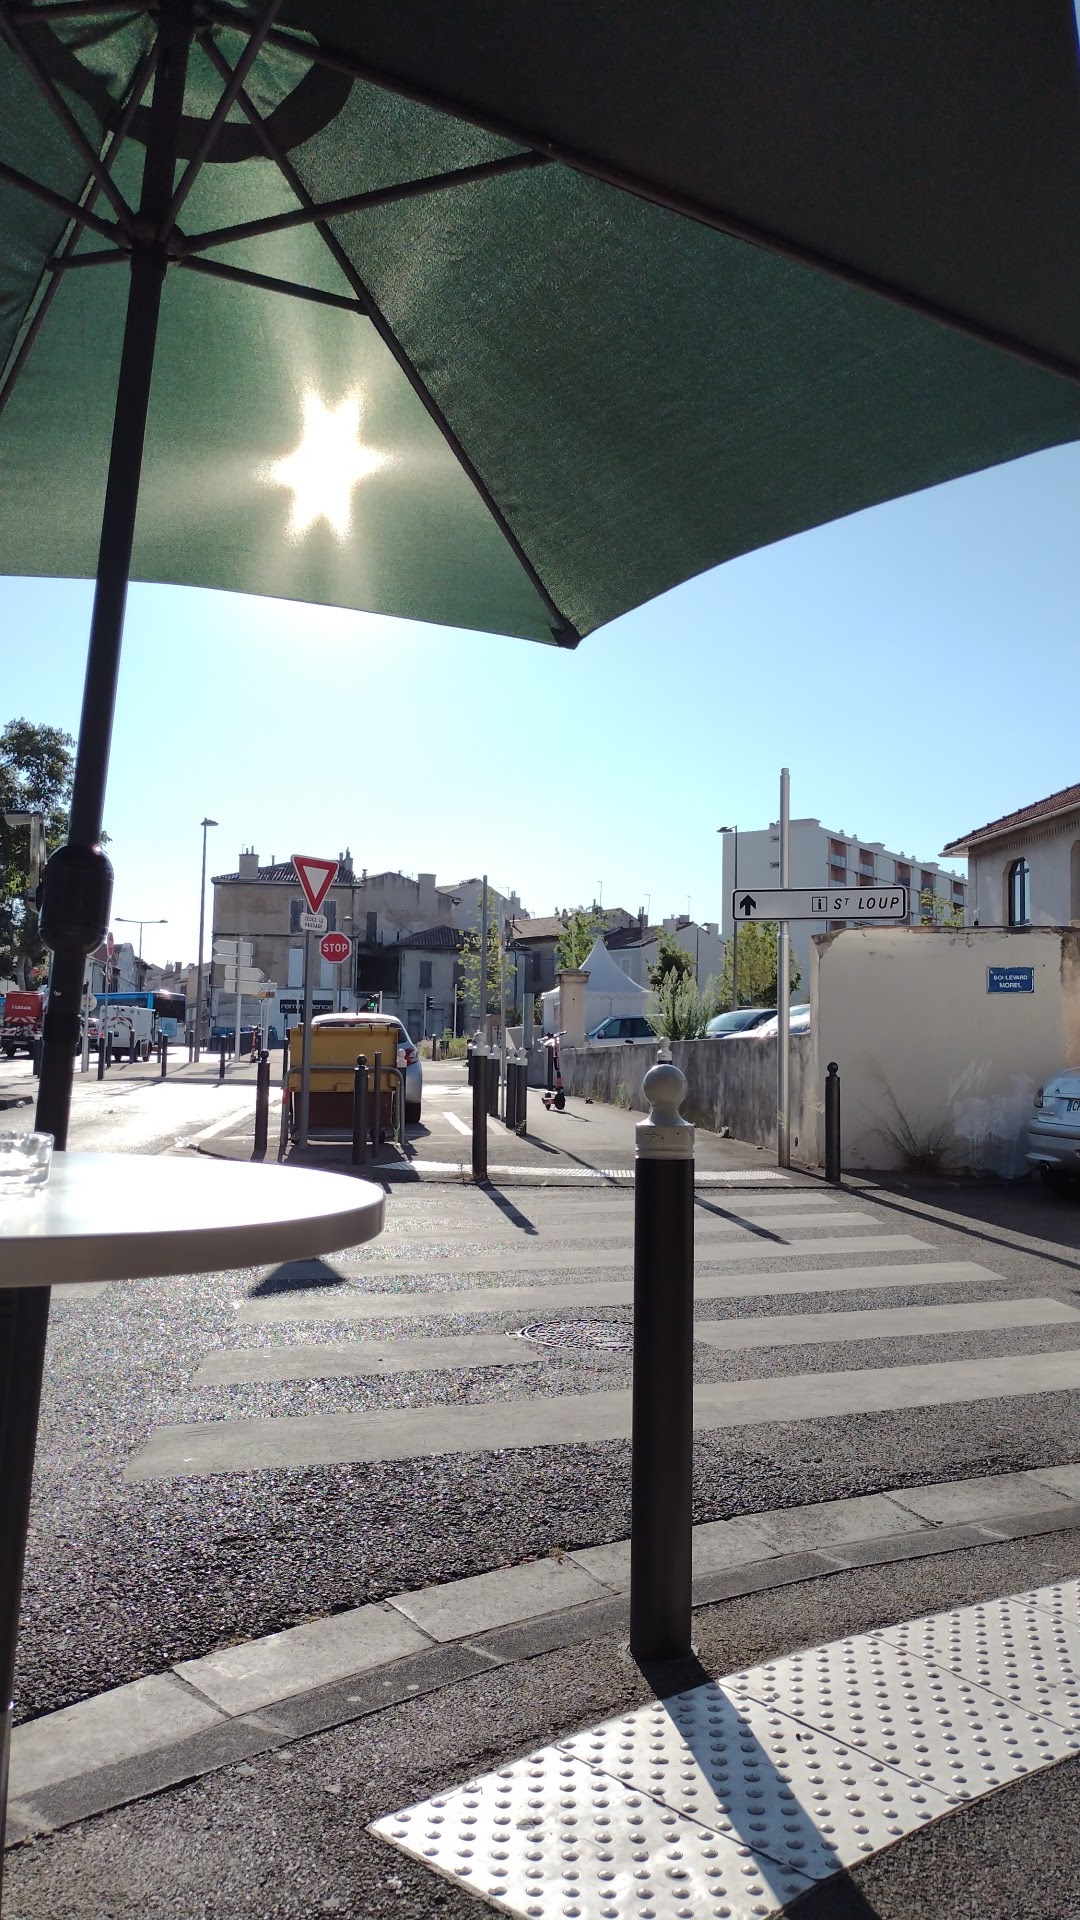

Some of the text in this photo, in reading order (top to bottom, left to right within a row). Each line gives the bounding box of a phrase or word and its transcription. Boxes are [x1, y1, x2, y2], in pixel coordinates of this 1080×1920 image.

[858, 897, 900, 910] LOUP
[304, 921, 323, 929] PASSAGE
[322, 943, 348, 953] STOP
